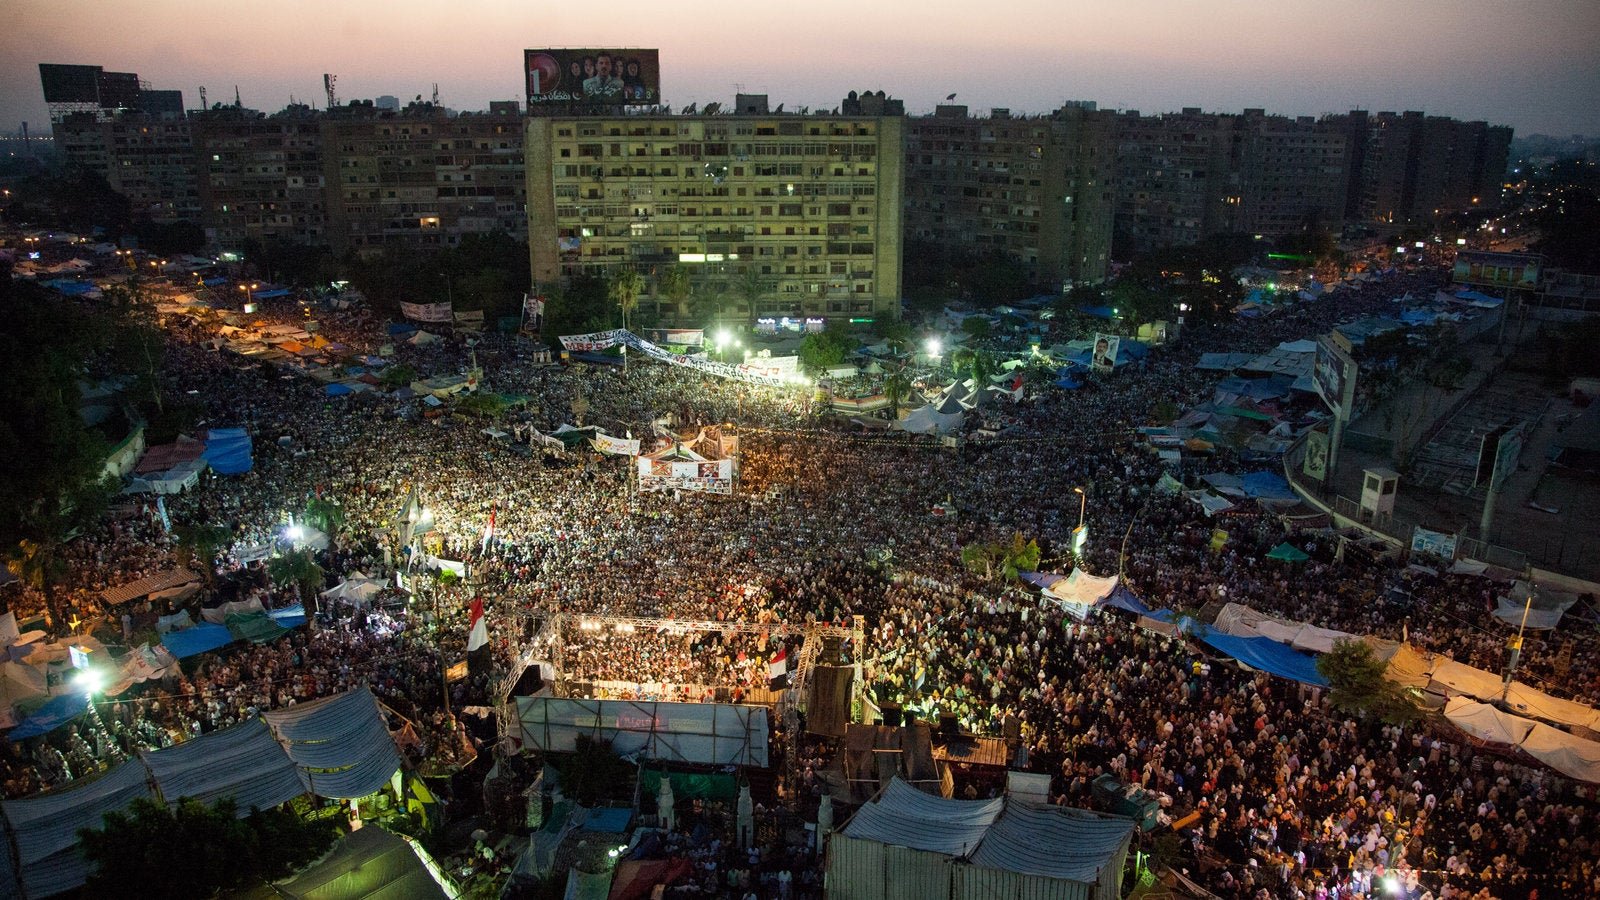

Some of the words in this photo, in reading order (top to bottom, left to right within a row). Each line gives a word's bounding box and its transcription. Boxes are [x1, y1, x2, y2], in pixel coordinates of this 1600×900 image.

[529, 69, 541, 95] 1
[530, 94, 548, 104] كريم
[548, 90, 571, 101] رمضان
[624, 91, 629, 99] 1
[635, 90, 641, 99] 2
[646, 91, 651, 99] 3
